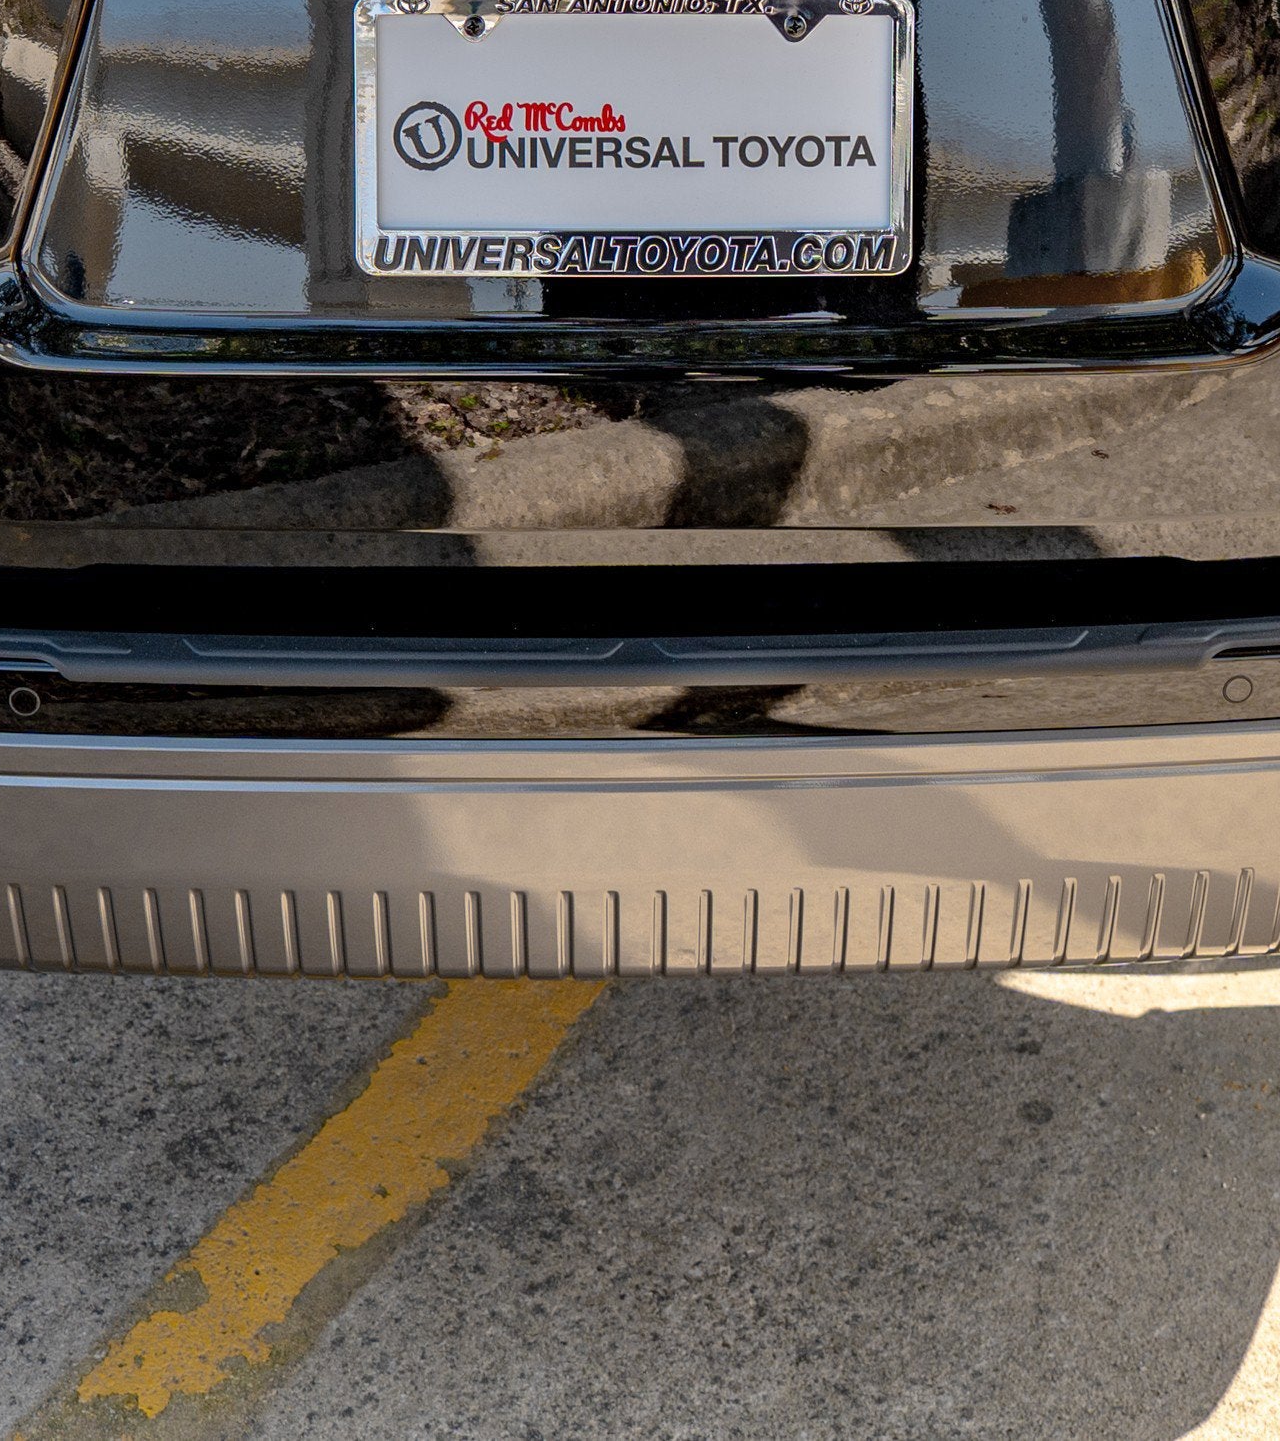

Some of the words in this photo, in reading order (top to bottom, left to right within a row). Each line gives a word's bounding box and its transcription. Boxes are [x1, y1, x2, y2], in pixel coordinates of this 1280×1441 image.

[464, 100, 514, 143] Red
[516, 102, 626, 133] McCombs
[467, 135, 705, 169] UNIVERSAL
[712, 134, 877, 169] TOYOTA
[374, 234, 897, 274] UNIVERSALTOYOTA.COM
